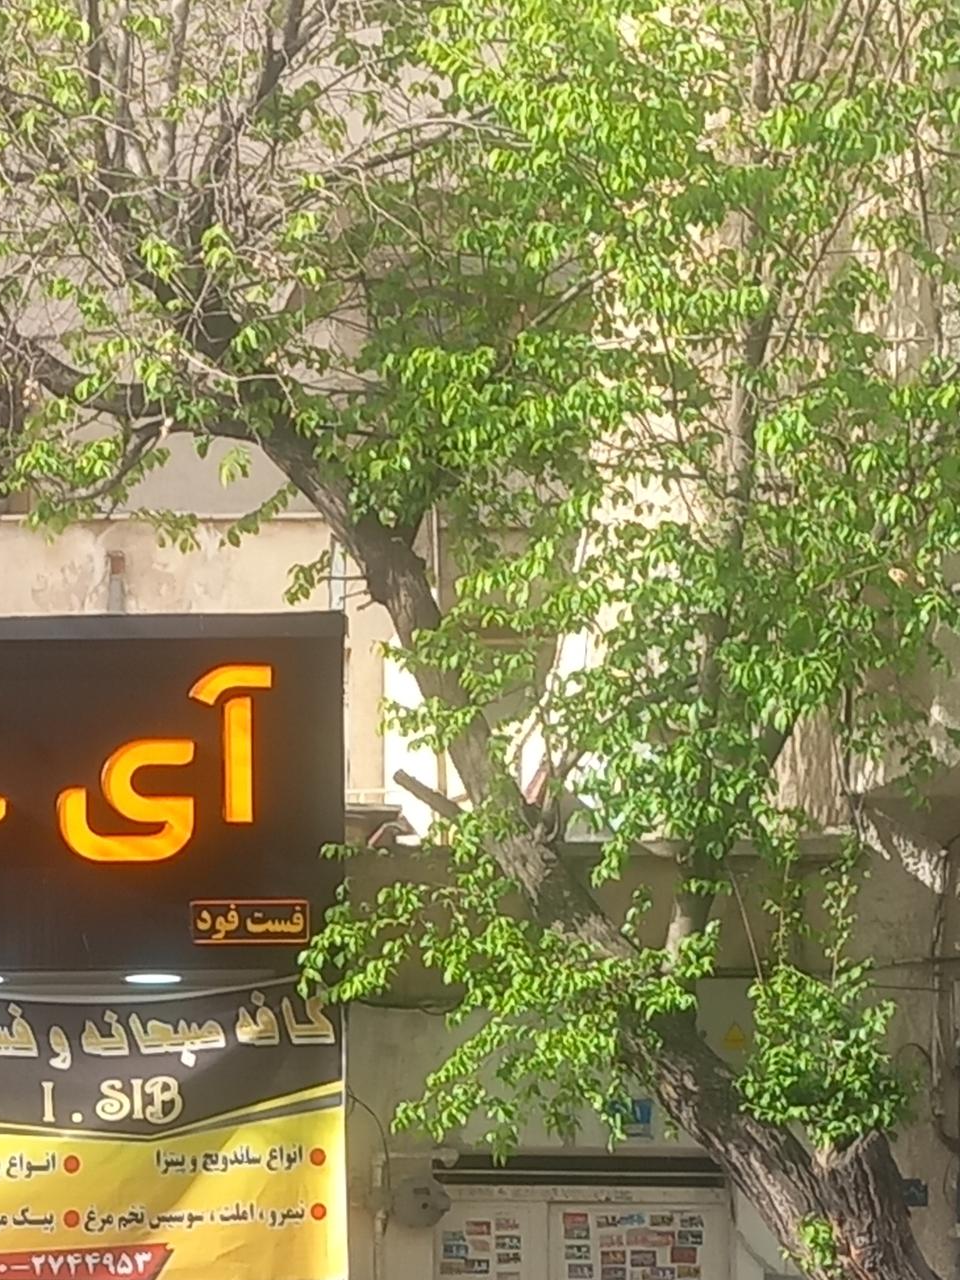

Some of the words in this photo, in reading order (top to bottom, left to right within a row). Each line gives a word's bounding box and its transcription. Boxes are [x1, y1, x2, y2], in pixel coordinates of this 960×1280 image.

[56, 665, 272, 862] آی
[196, 903, 239, 939] فود
[245, 906, 304, 933] فست
[235, 990, 336, 1045] کافه
[48, 1025, 72, 1070] و
[81, 1009, 226, 1068] صبحانه
[6, 1152, 56, 1179] انواع
[202, 1147, 262, 1173] ساندویچ
[266, 1144, 303, 1170] انواع
[13, 1207, 54, 1232] پیک
[84, 1204, 114, 1232] مرغ
[117, 1204, 145, 1231] تخم
